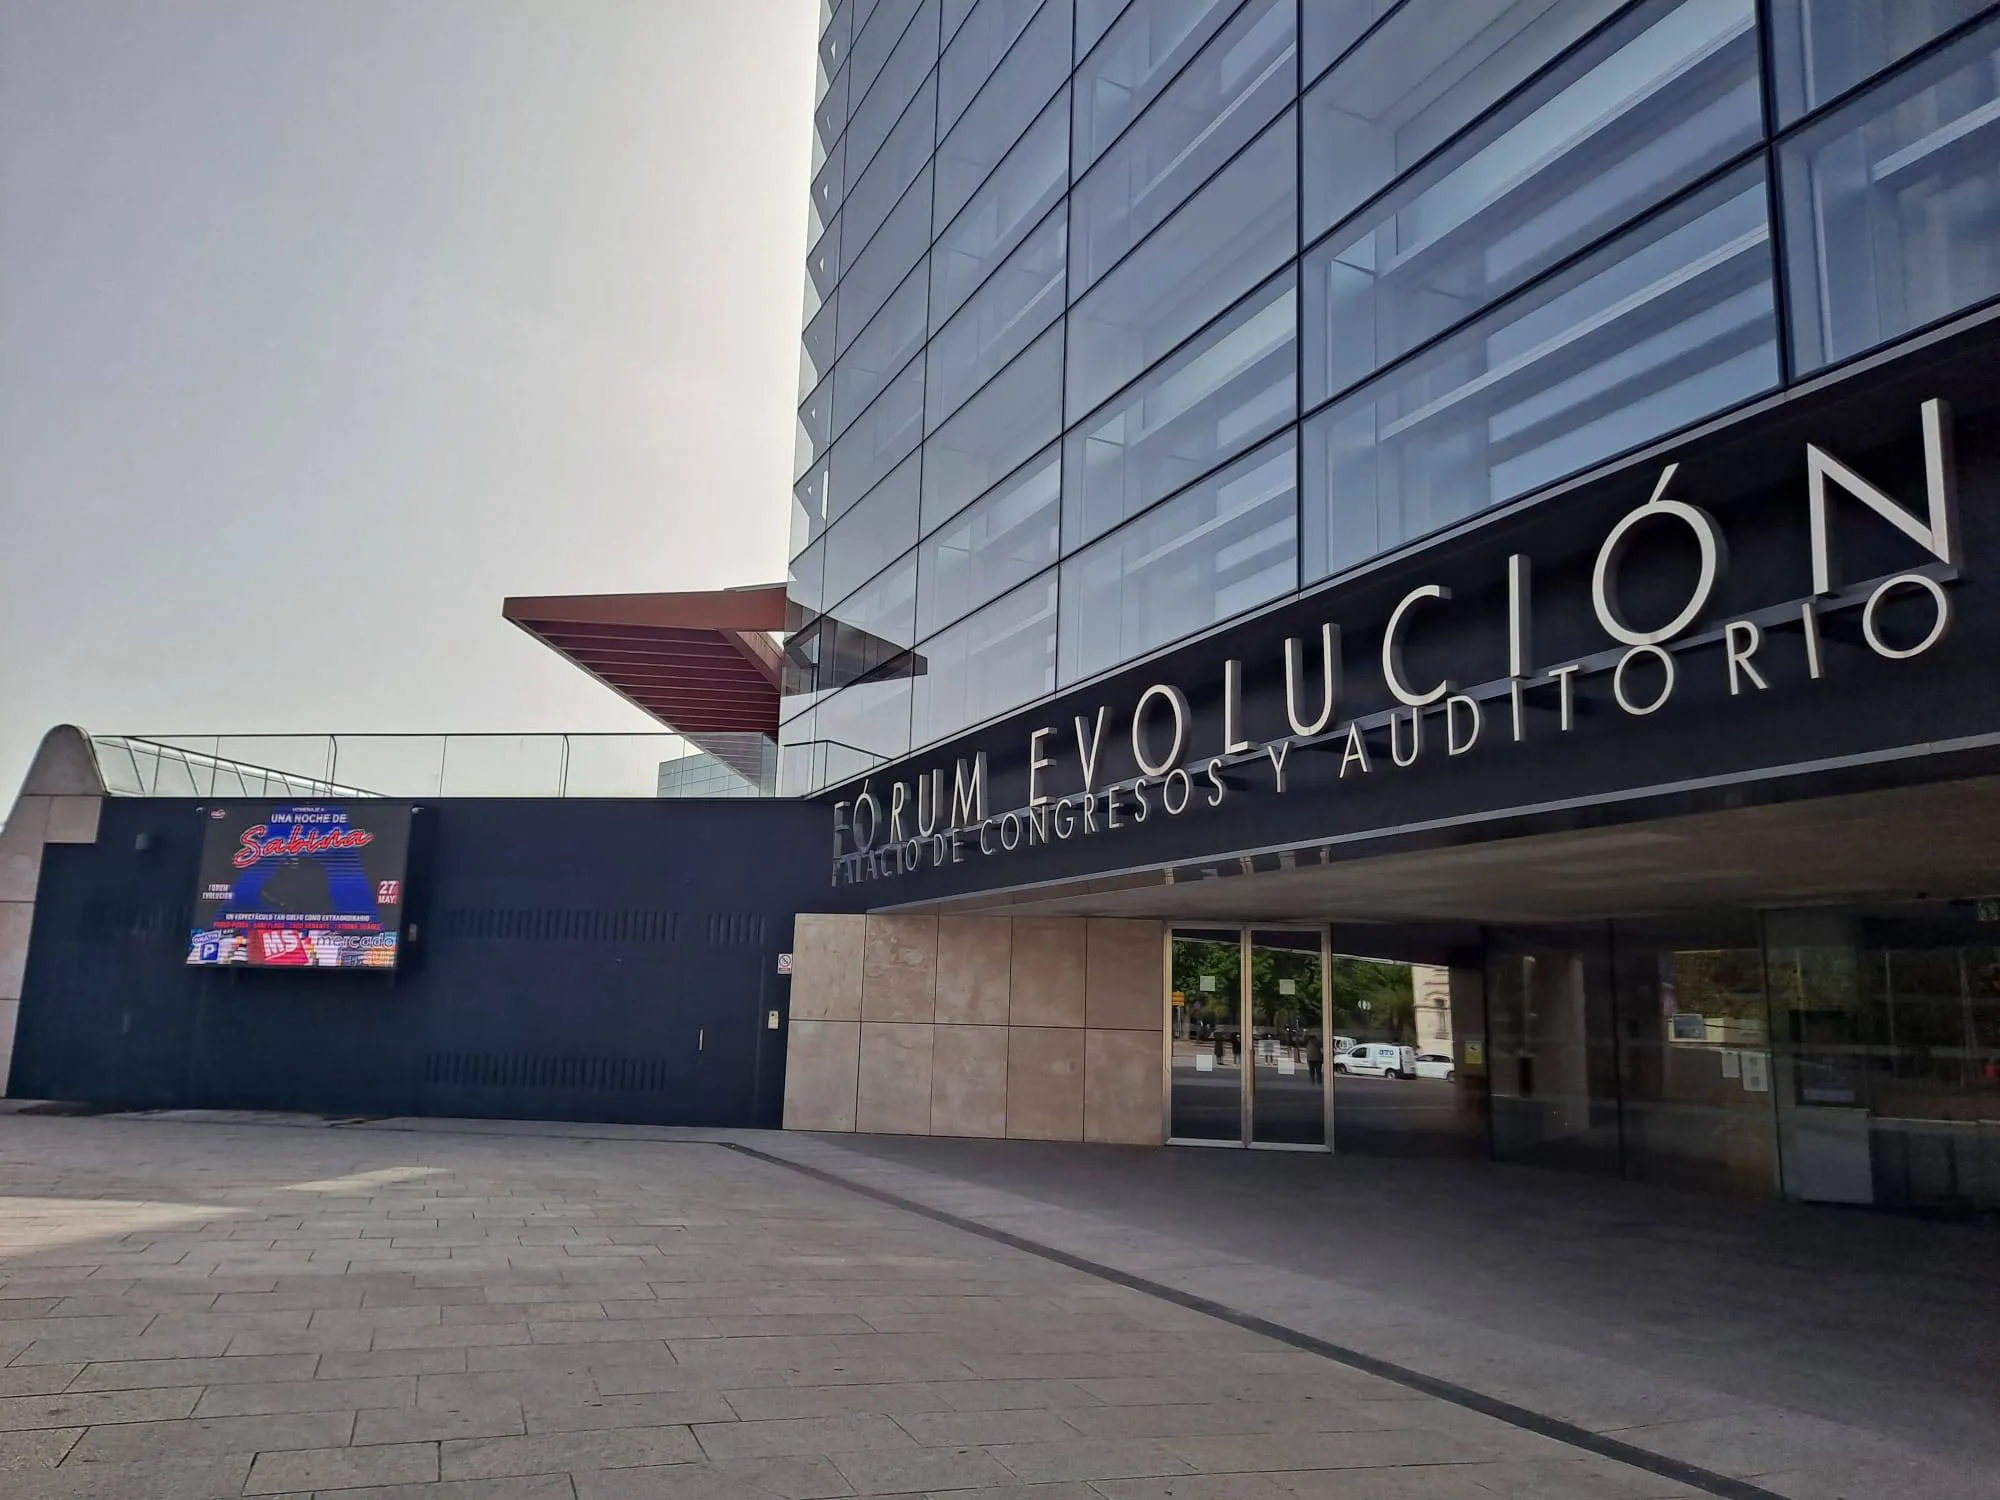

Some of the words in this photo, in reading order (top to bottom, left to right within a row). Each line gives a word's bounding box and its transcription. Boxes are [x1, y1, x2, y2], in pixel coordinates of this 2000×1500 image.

[832, 751, 989, 858] FÓRUM
[1030, 397, 1958, 806] EVOLUCIÓN
[831, 838, 919, 887] PALACIO
[933, 828, 966, 867] DE
[980, 758, 1227, 856] CONGRESOS
[1266, 741, 1296, 792] Y
[1338, 573, 1949, 778] AUDITORIO
[271, 813, 293, 823] UNA
[294, 813, 330, 823] NOCHE
[332, 814, 347, 823] DE
[232, 824, 374, 869] Sabina
[379, 880, 398, 895] 27
[274, 913, 286, 921] TAN
[304, 914, 321, 922] COMO
[317, 932, 397, 950] mercado
